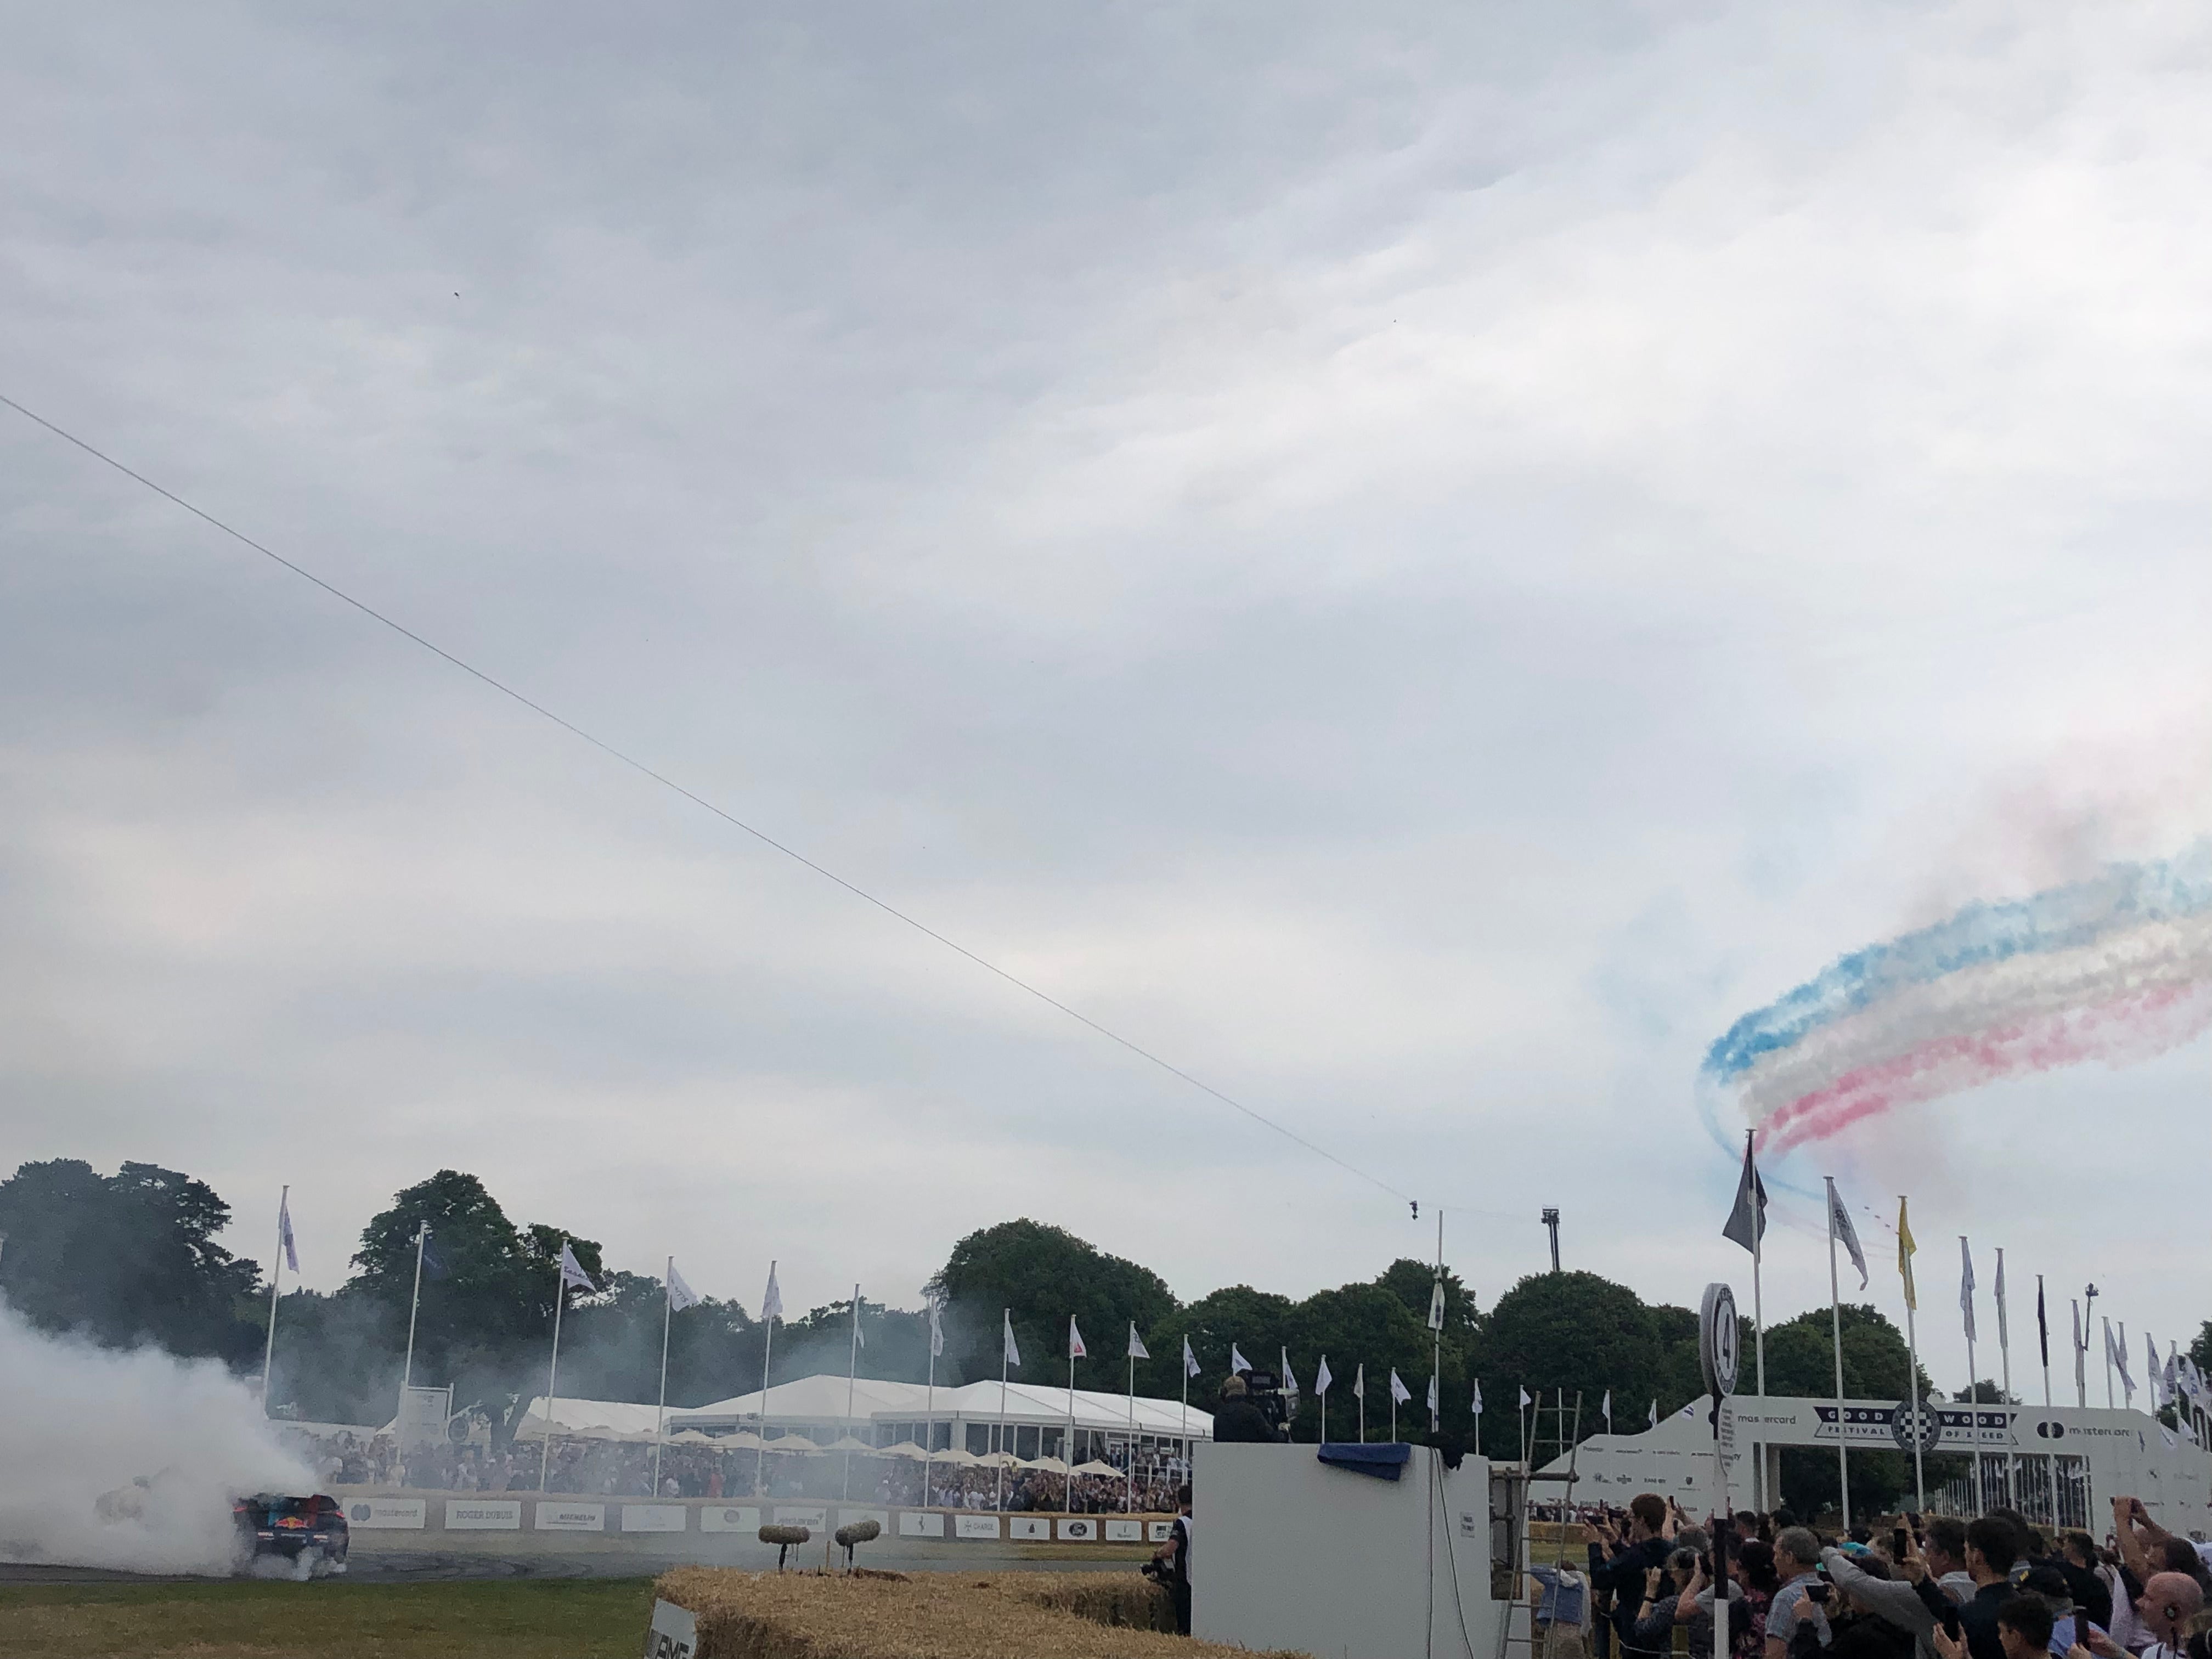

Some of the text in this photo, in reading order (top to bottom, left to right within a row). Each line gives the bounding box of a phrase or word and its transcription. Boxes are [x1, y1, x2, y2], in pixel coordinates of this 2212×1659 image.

[1723, 1313, 1731, 1369] 4
[1738, 1414, 1796, 1425] masercard
[1944, 1415, 2004, 1425] WOOD
[1828, 1426, 1884, 1435] FETIVAL
[1966, 1431, 2004, 1440] SEED
[456, 1510, 483, 1519] ROGER
